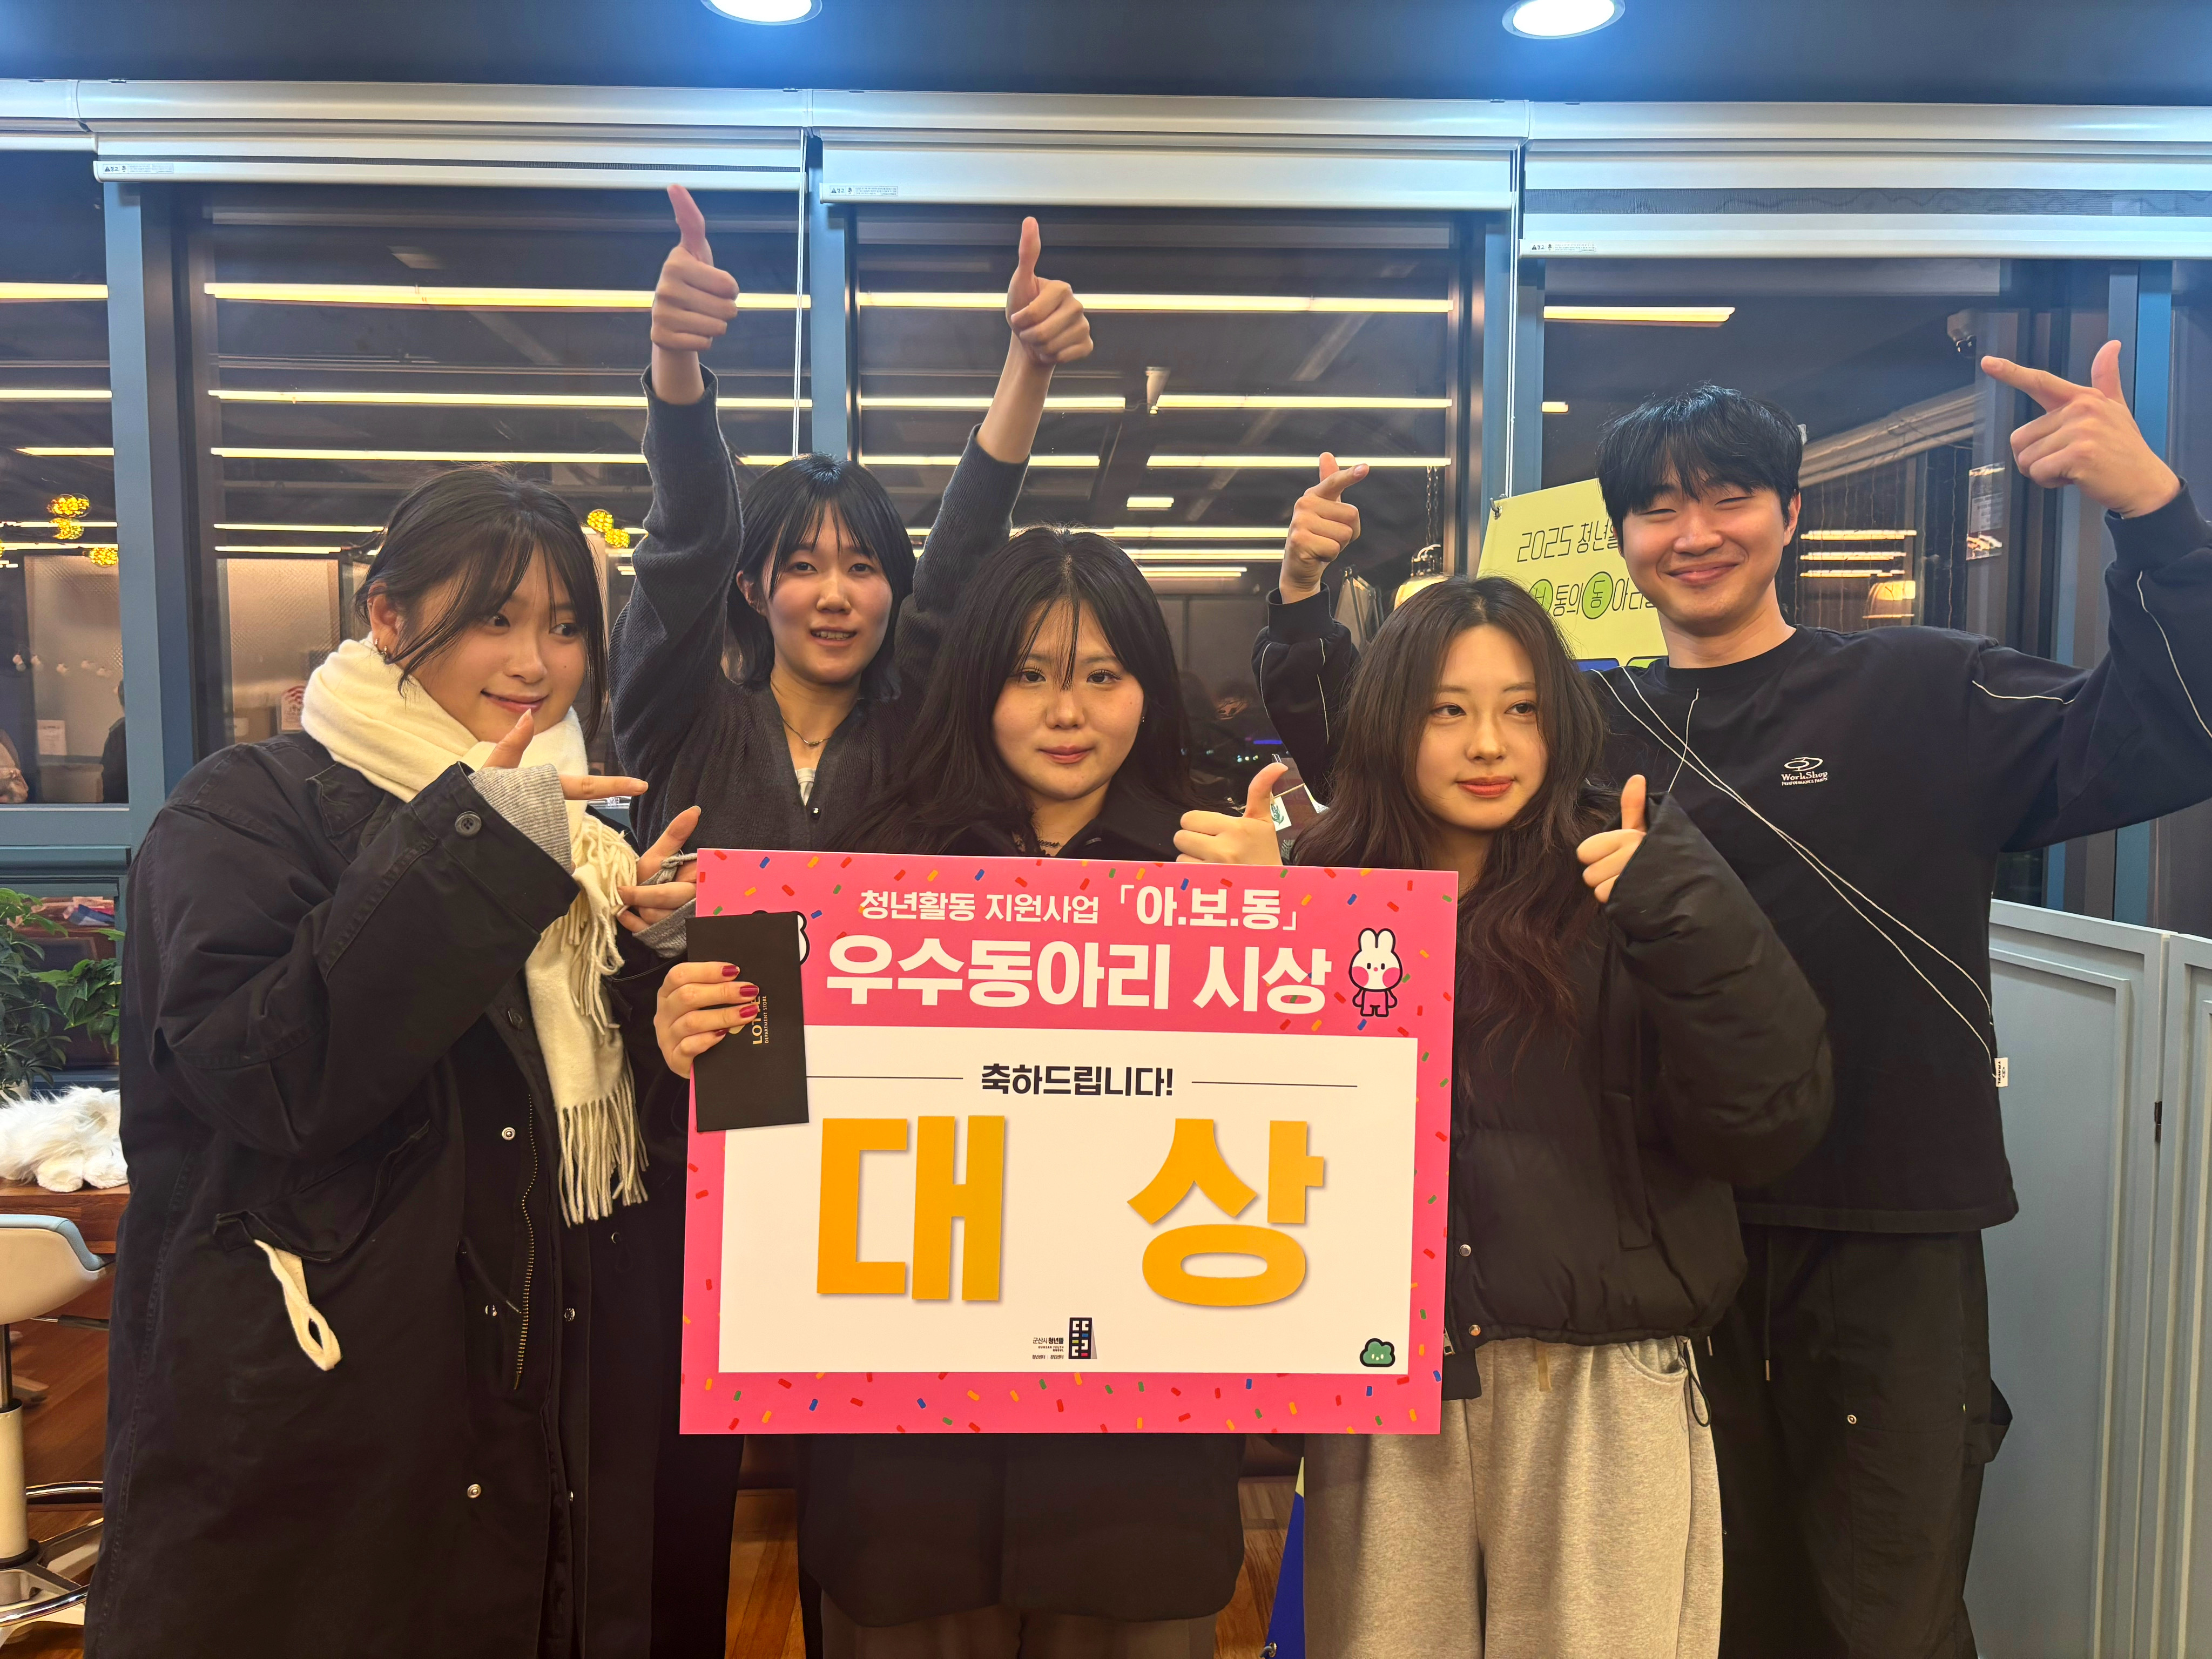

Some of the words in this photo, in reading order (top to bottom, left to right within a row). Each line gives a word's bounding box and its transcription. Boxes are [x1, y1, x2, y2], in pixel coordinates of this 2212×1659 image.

[1517, 524, 1574, 562] 2025
[860, 889, 976, 921] 청년활동
[984, 893, 1099, 924] 지원사업
[826, 934, 1170, 1009] 우수동아리
[1192, 946, 1332, 1014] 시상
[751, 996, 763, 1045] LOTE
[981, 1063, 1174, 1097] 축하드립니다!
